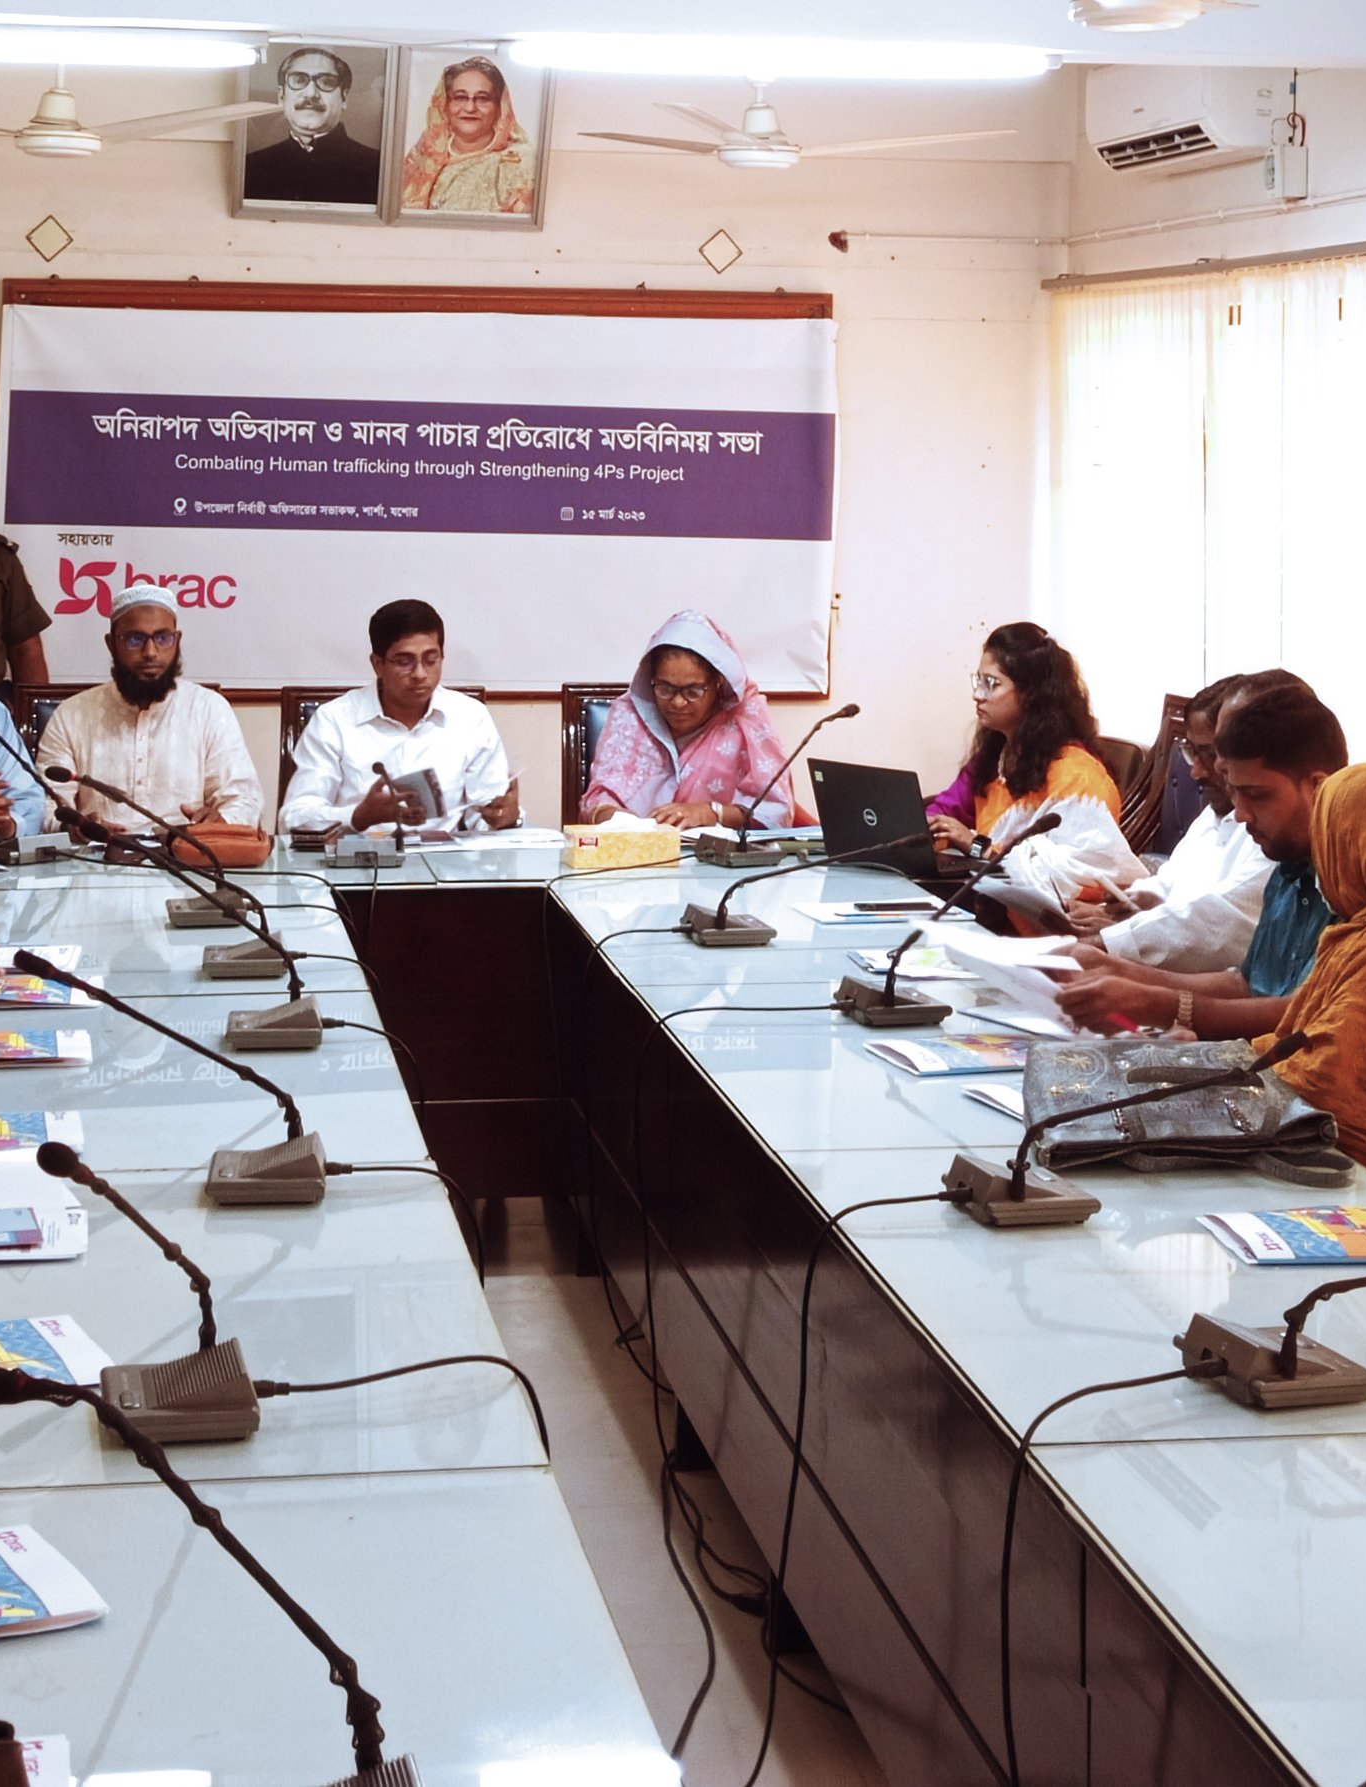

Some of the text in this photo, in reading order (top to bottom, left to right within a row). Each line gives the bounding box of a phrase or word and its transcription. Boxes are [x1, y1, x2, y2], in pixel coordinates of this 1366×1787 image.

[91, 407, 764, 455] অনিরাপদ অভিবাসন ও মানব পাচার প্রতিরোধে মতবিনিময় সভা
[175, 453, 685, 484] Combating Human trafficking through Strengthening 4Ps Project
[617, 510, 646, 521] ২০২৩
[58, 533, 114, 546] সহায়তায়
